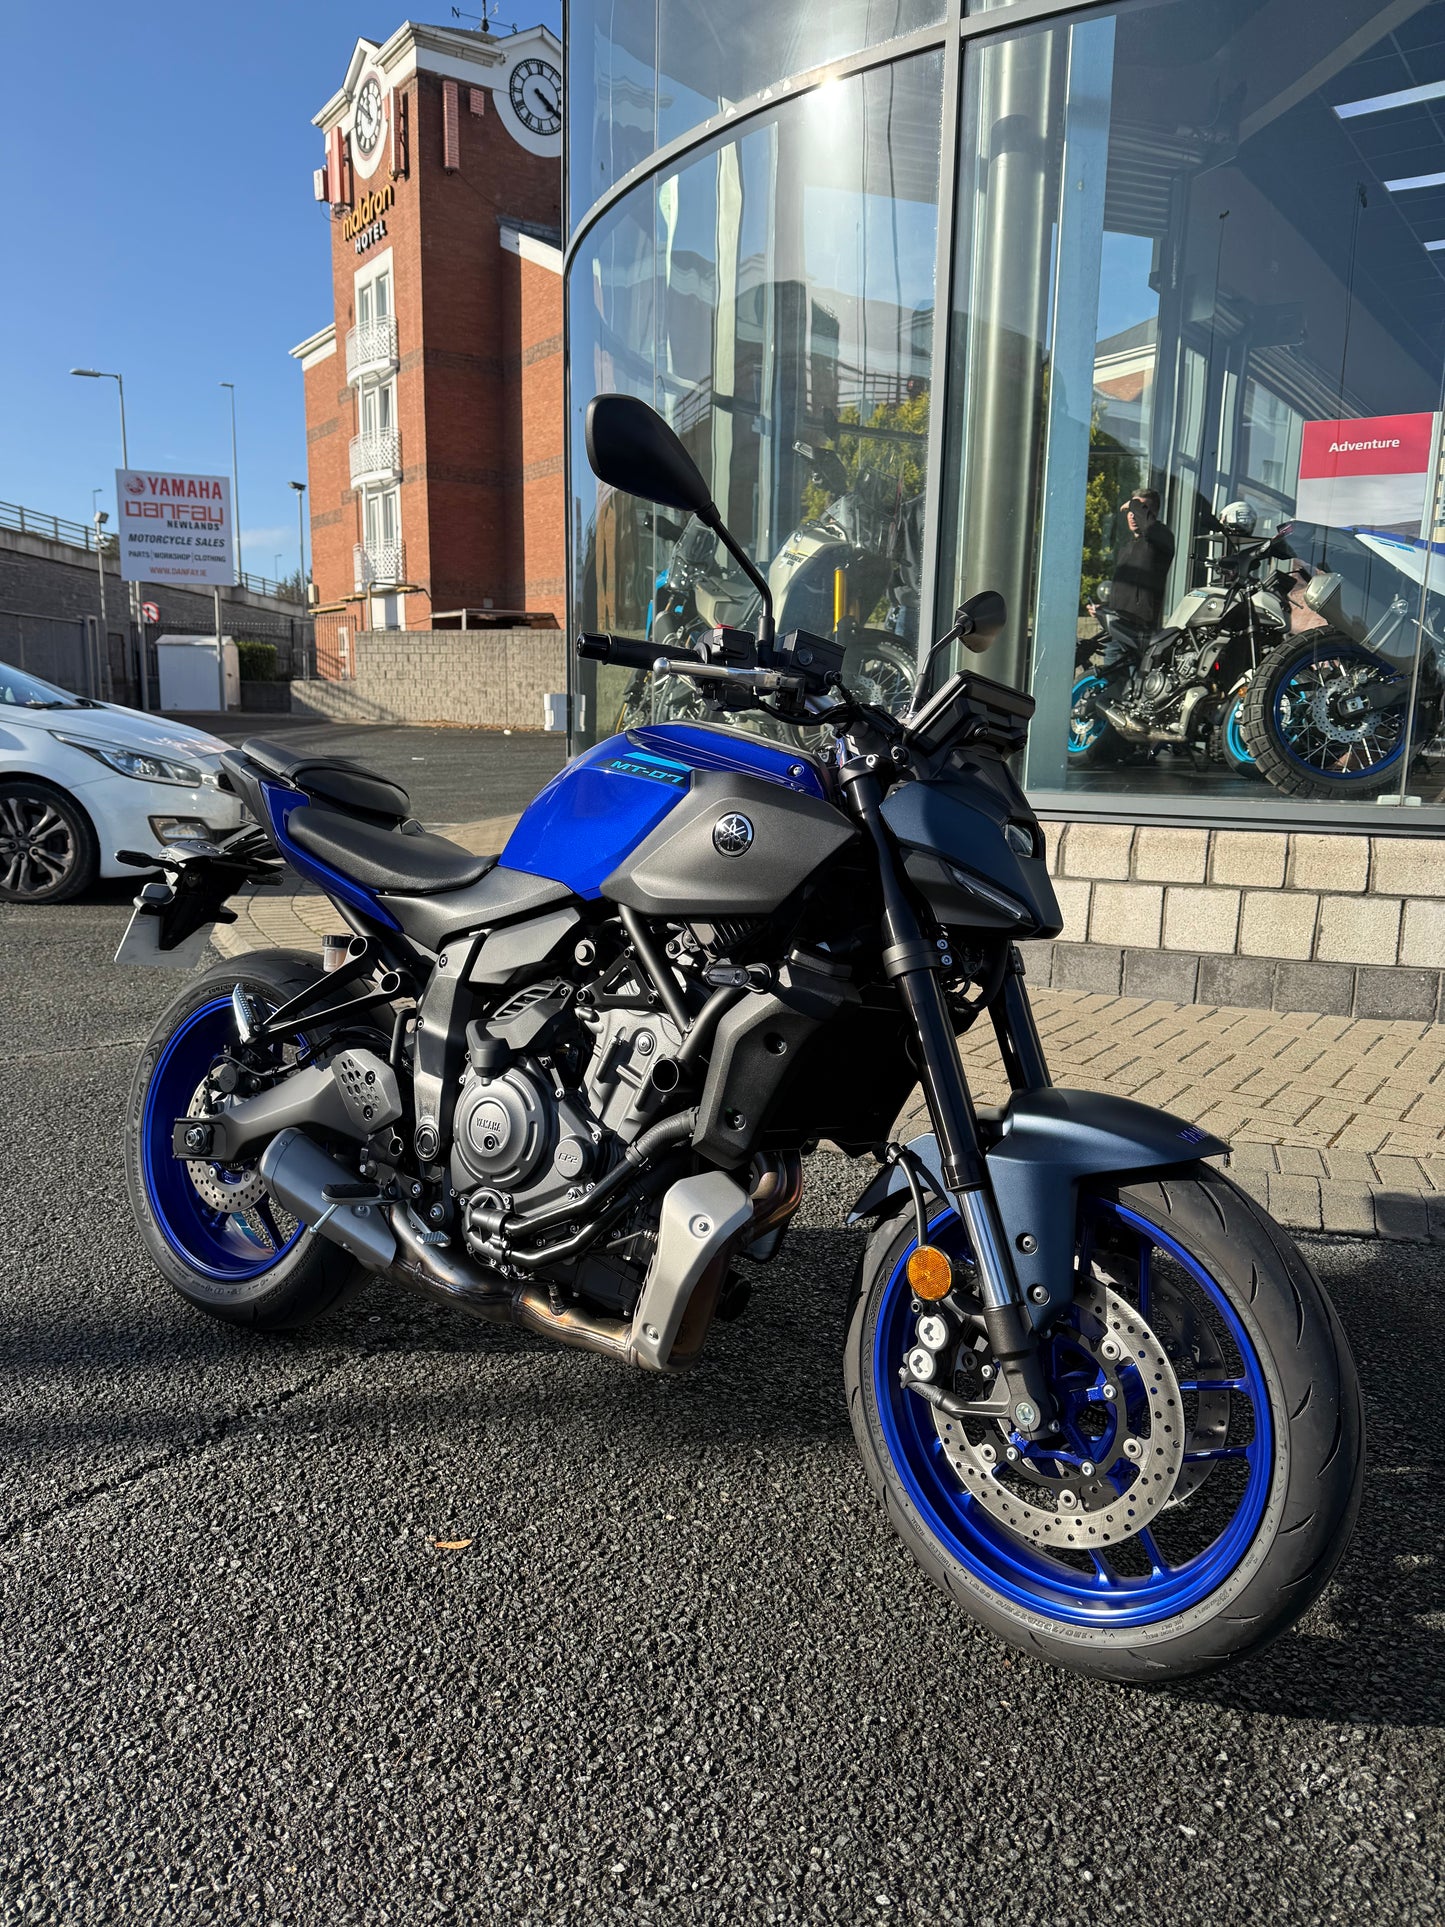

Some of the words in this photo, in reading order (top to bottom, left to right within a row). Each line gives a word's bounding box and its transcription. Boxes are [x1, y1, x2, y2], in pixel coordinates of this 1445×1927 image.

[342, 184, 393, 241] maldron
[354, 220, 387, 254] HOTEL
[1328, 439, 1400, 452] Adventure
[148, 477, 222, 499] YAMAHA
[167, 520, 220, 531] NEWLANDS
[128, 533, 192, 546] MOTORCYCLE
[195, 537, 225, 548] SALES
[128, 550, 150, 558] PARTS
[153, 552, 191, 560] WORKSHOP
[194, 554, 226, 563] CLOTHING
[610, 760, 684, 783] MT-07
[476, 1117, 501, 1132] YAMAHA
